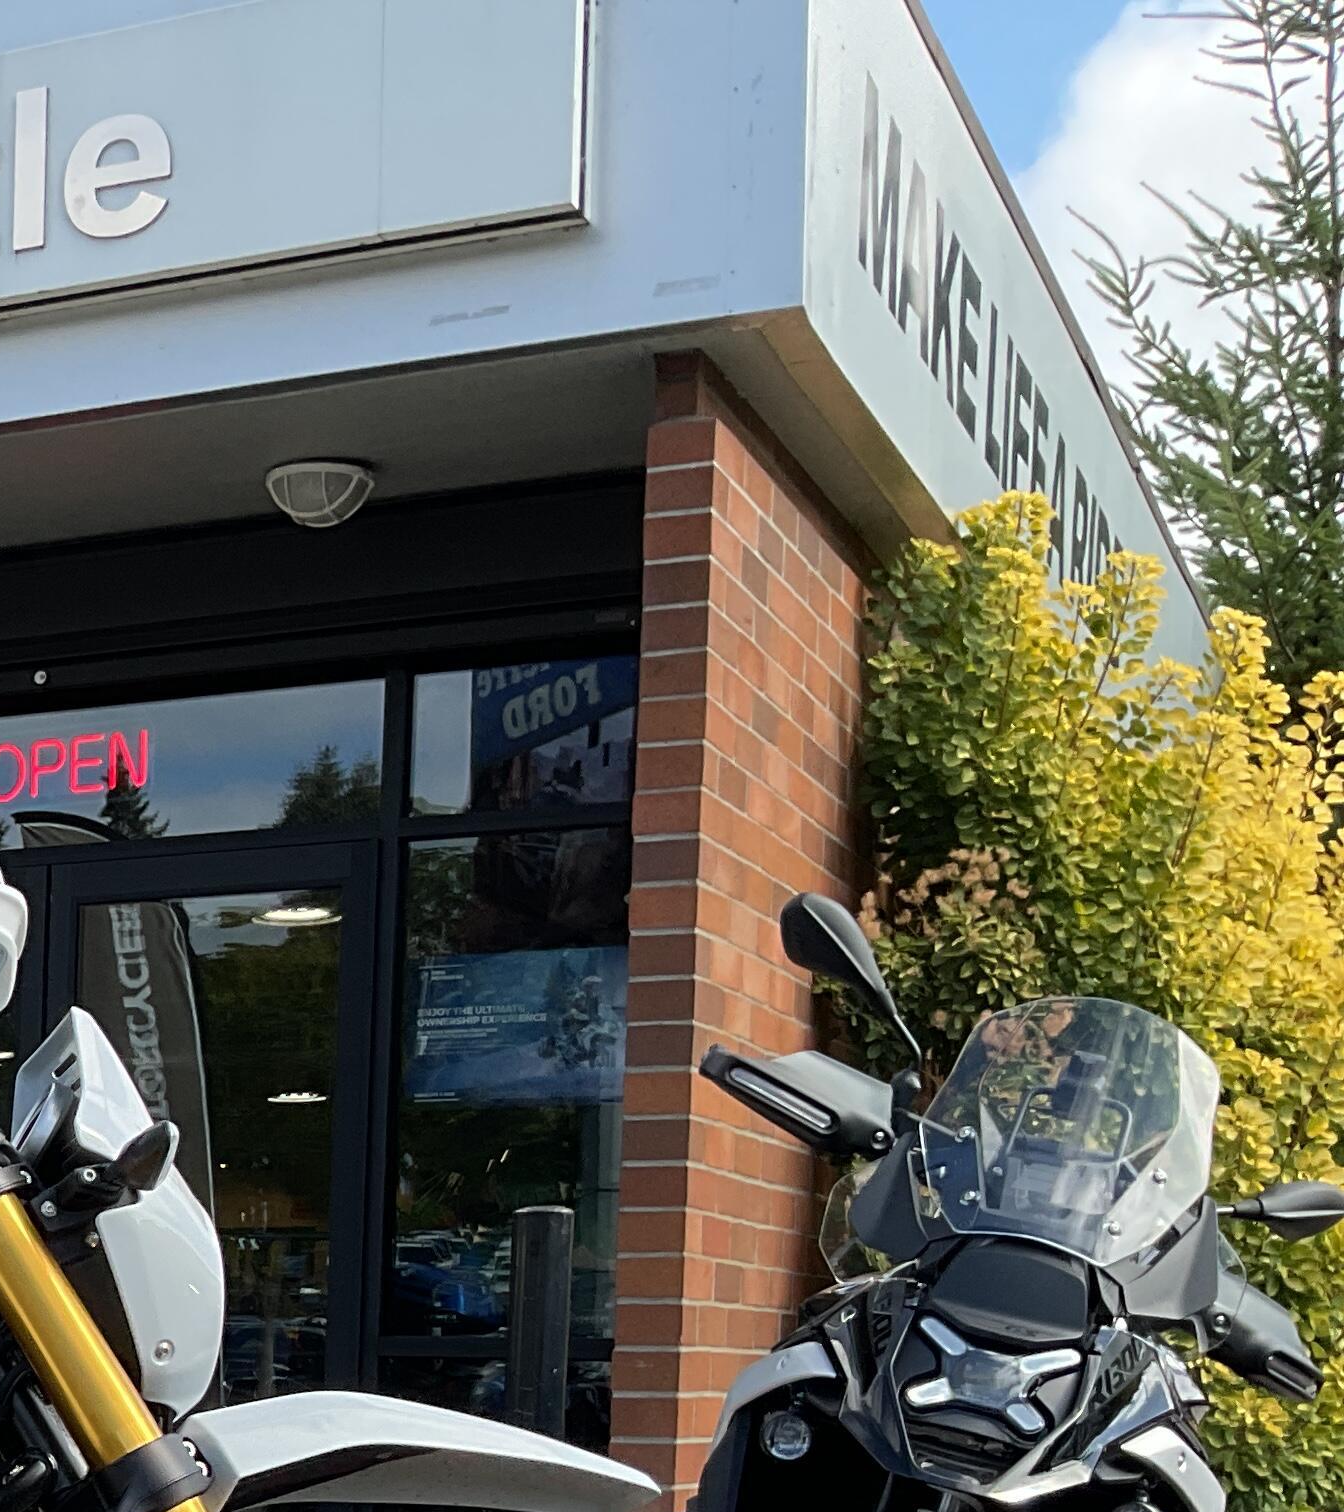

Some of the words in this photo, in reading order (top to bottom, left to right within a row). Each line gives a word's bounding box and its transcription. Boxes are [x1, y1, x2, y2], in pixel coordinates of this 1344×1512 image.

[858, 69, 982, 443] MAKE
[417, 1006, 452, 1018] ENJOY
[453, 1005, 473, 1016] THE
[417, 1016, 480, 1027] OWNERSHIP
